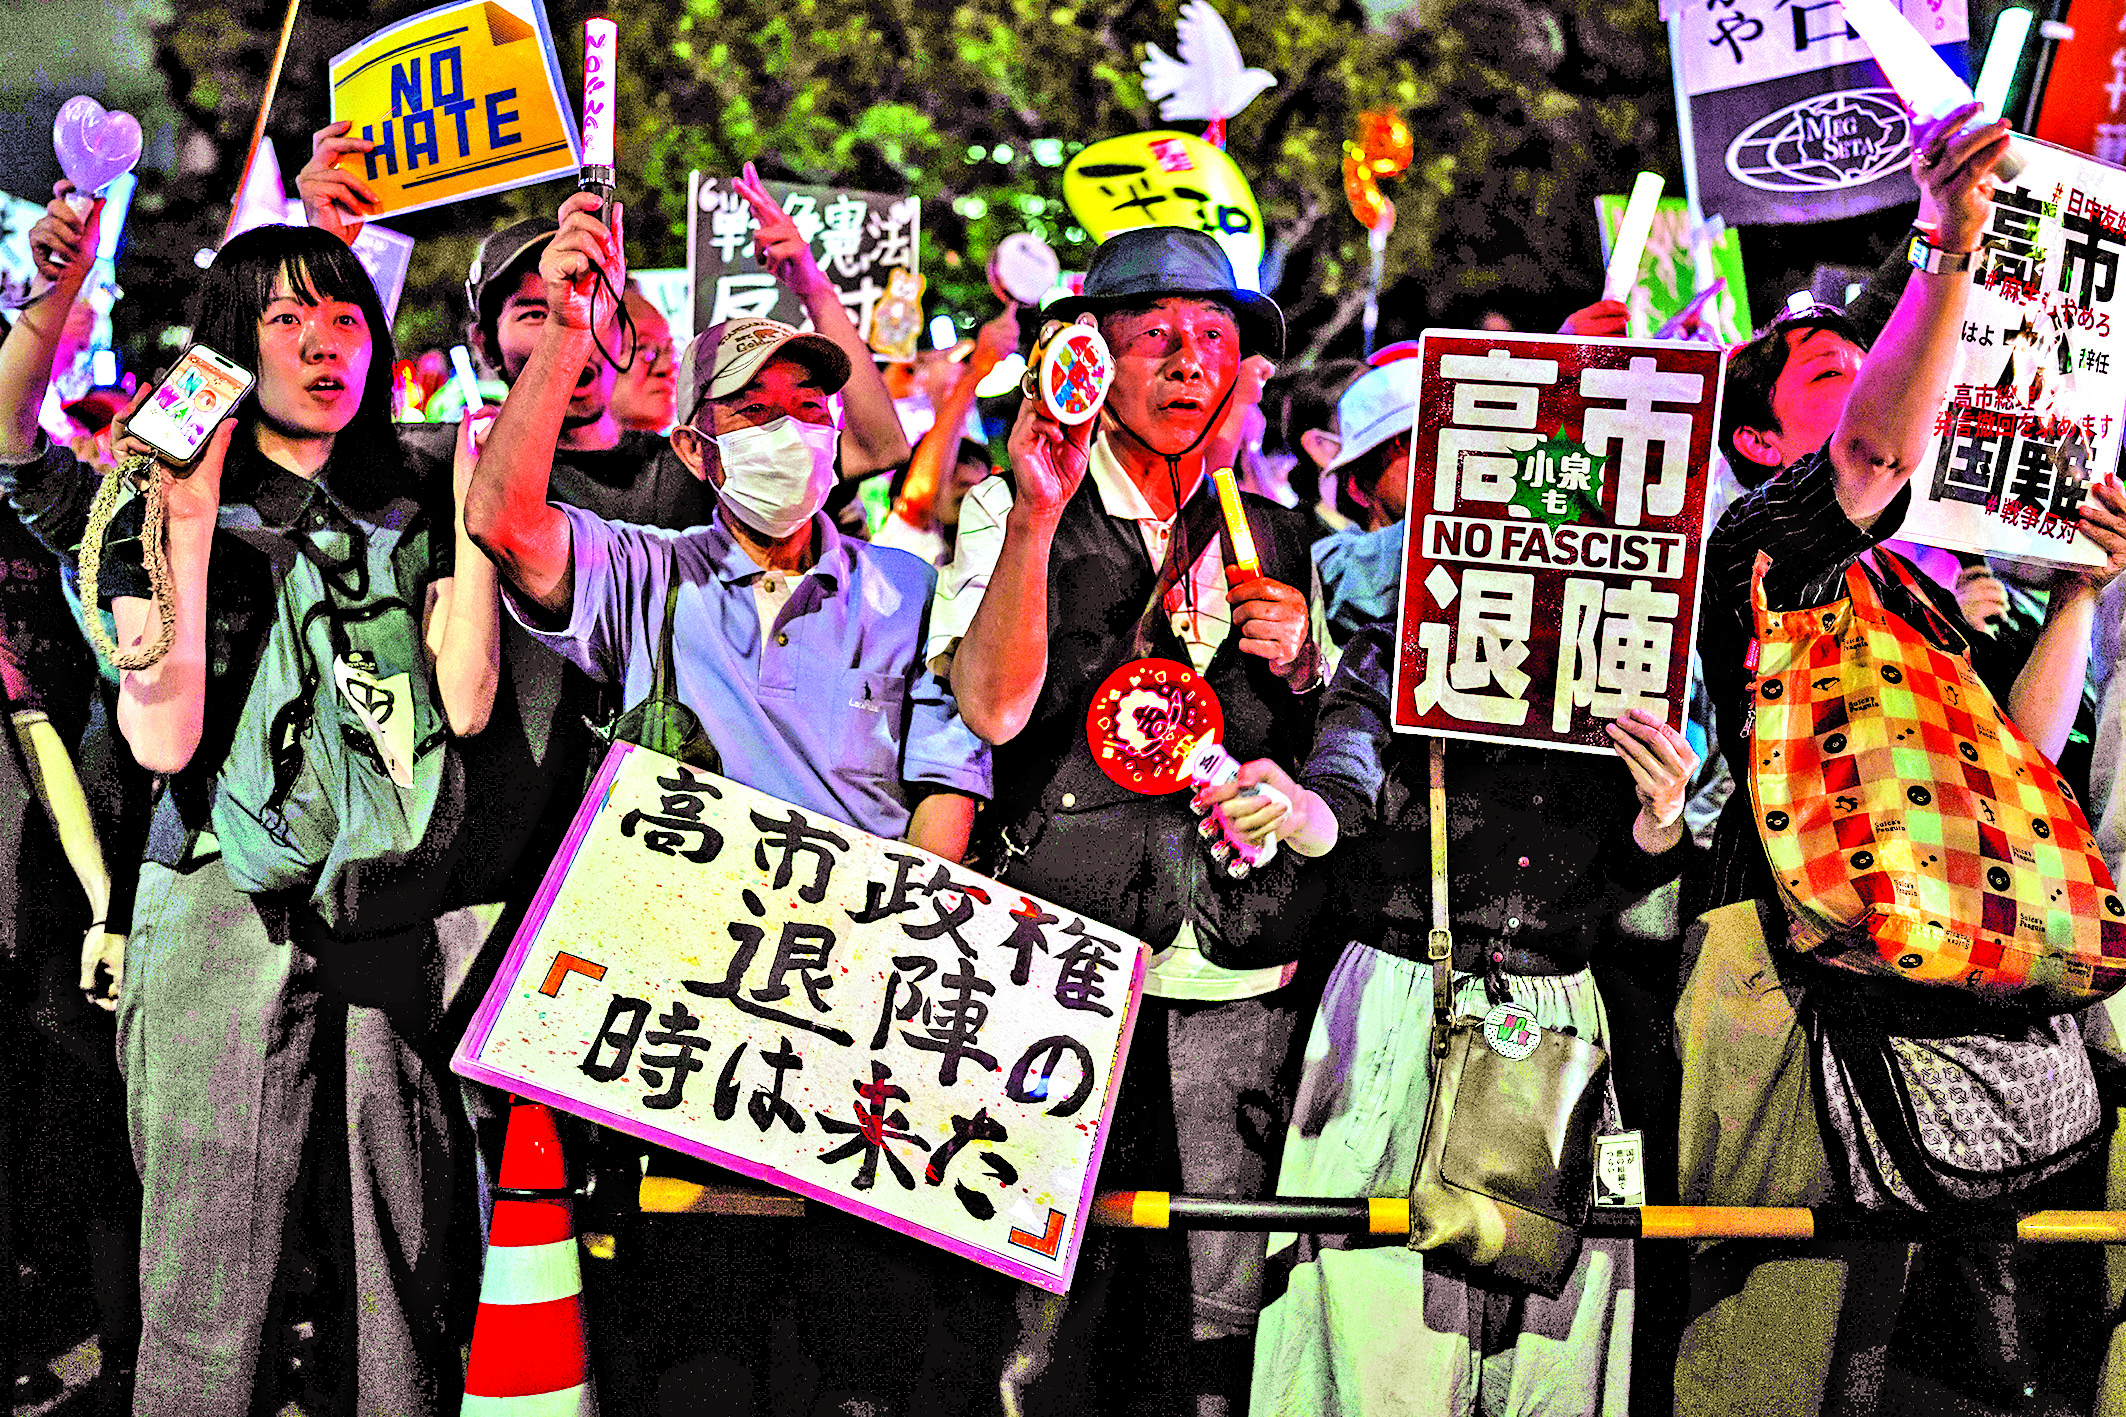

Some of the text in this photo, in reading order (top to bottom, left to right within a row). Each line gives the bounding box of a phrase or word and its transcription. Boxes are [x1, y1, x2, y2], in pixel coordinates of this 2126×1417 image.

[391, 45, 464, 118] NO
[362, 87, 522, 180] HATE
[1973, 185, 2126, 312] 高市
[1961, 320, 1995, 347] はよ
[153, 384, 205, 446] WAR
[176, 366, 218, 413] NO
[1433, 349, 1704, 527] 高市
[1929, 401, 2097, 522] 国難
[1522, 450, 1592, 492] 小泉
[1541, 489, 1568, 515] も
[1985, 494, 2080, 545] #戦争反対
[1432, 520, 1680, 574] NO FASCIST
[1413, 564, 1681, 734] 退陣
[1875, 819, 1901, 828] Suica's
[620, 767, 1123, 1019] 高市政権
[2019, 912, 2042, 925] Suica's
[684, 888, 1094, 1118] 退陣の
[1504, 1014, 1527, 1032] NO
[1497, 1026, 1530, 1046] WAR
